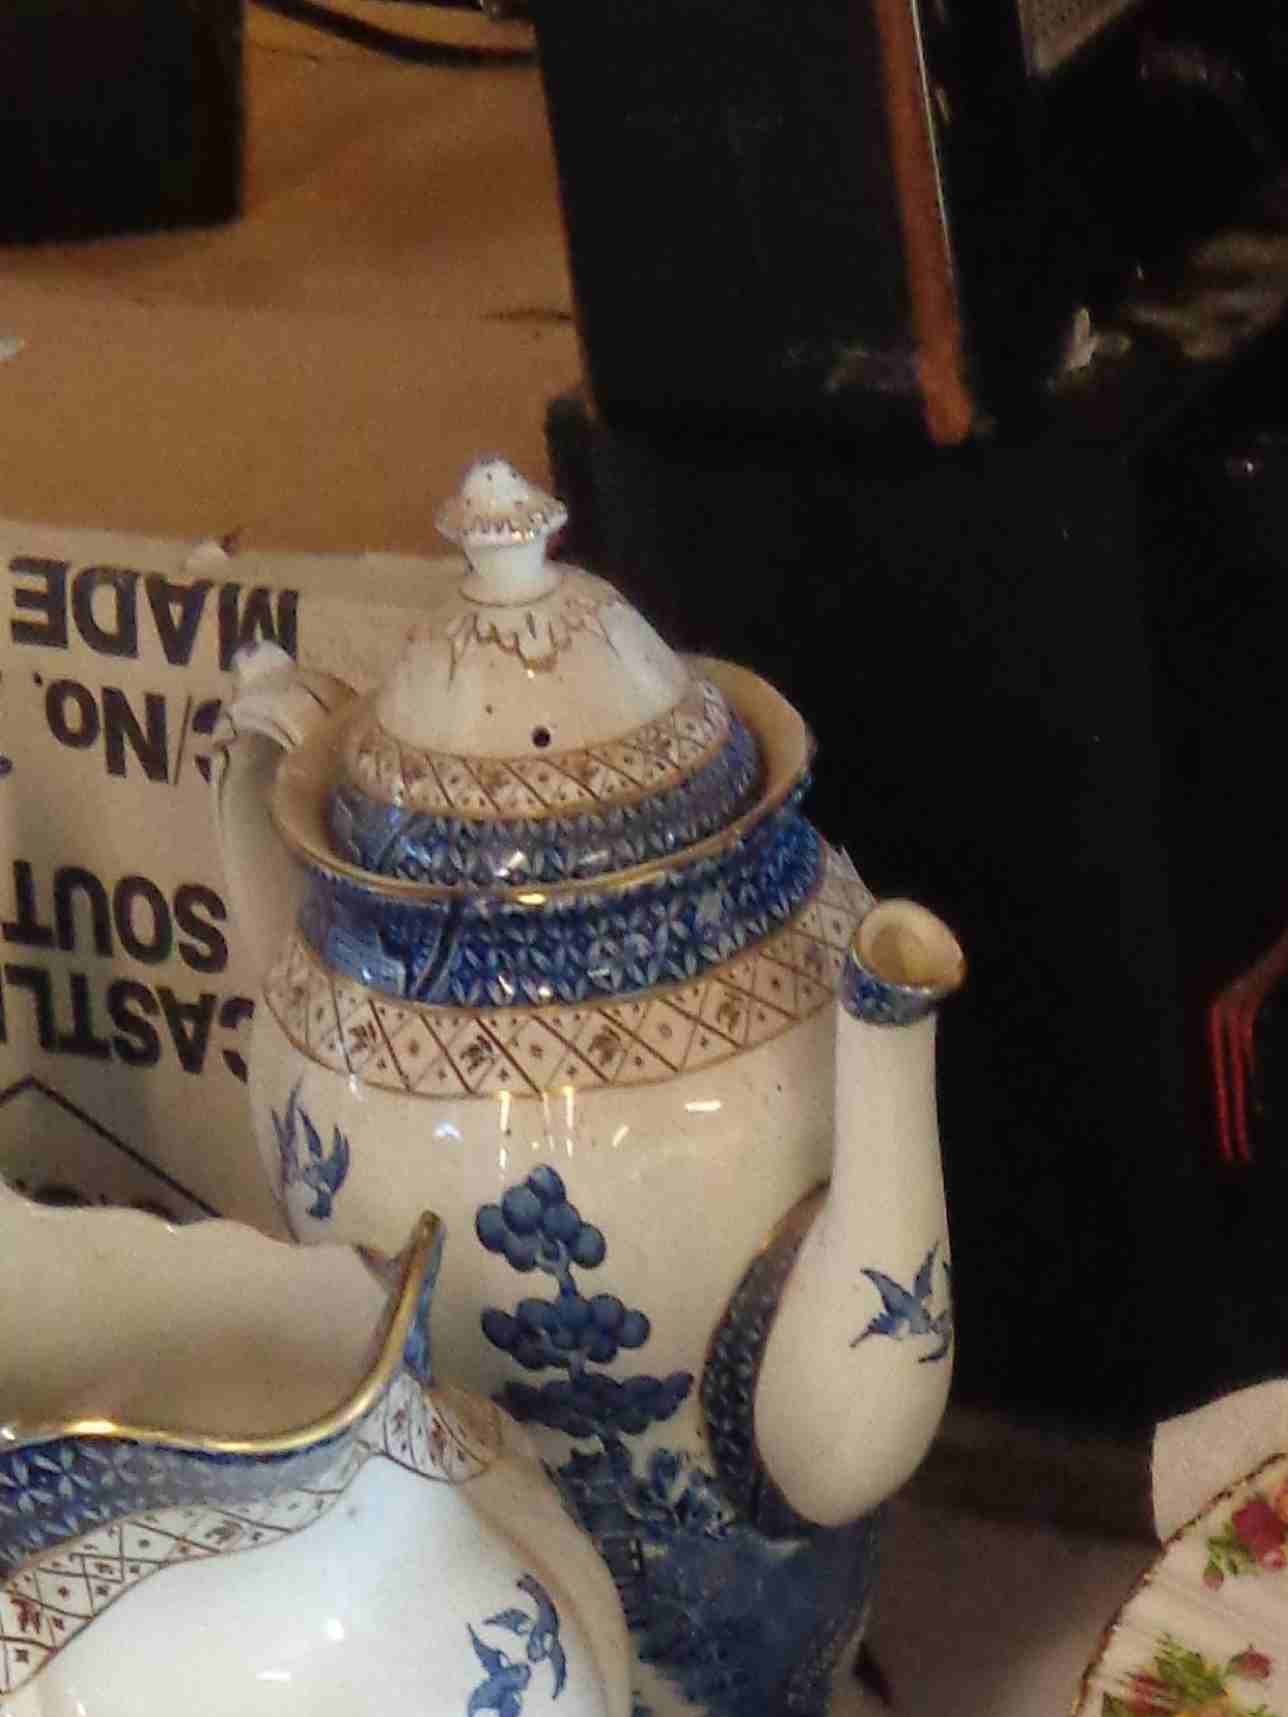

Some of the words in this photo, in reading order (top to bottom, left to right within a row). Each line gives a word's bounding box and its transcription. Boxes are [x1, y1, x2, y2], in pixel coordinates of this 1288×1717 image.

[9, 557, 298, 671] MADE
[2, 860, 228, 973] SOUT
[0, 962, 254, 1084] ASTL
